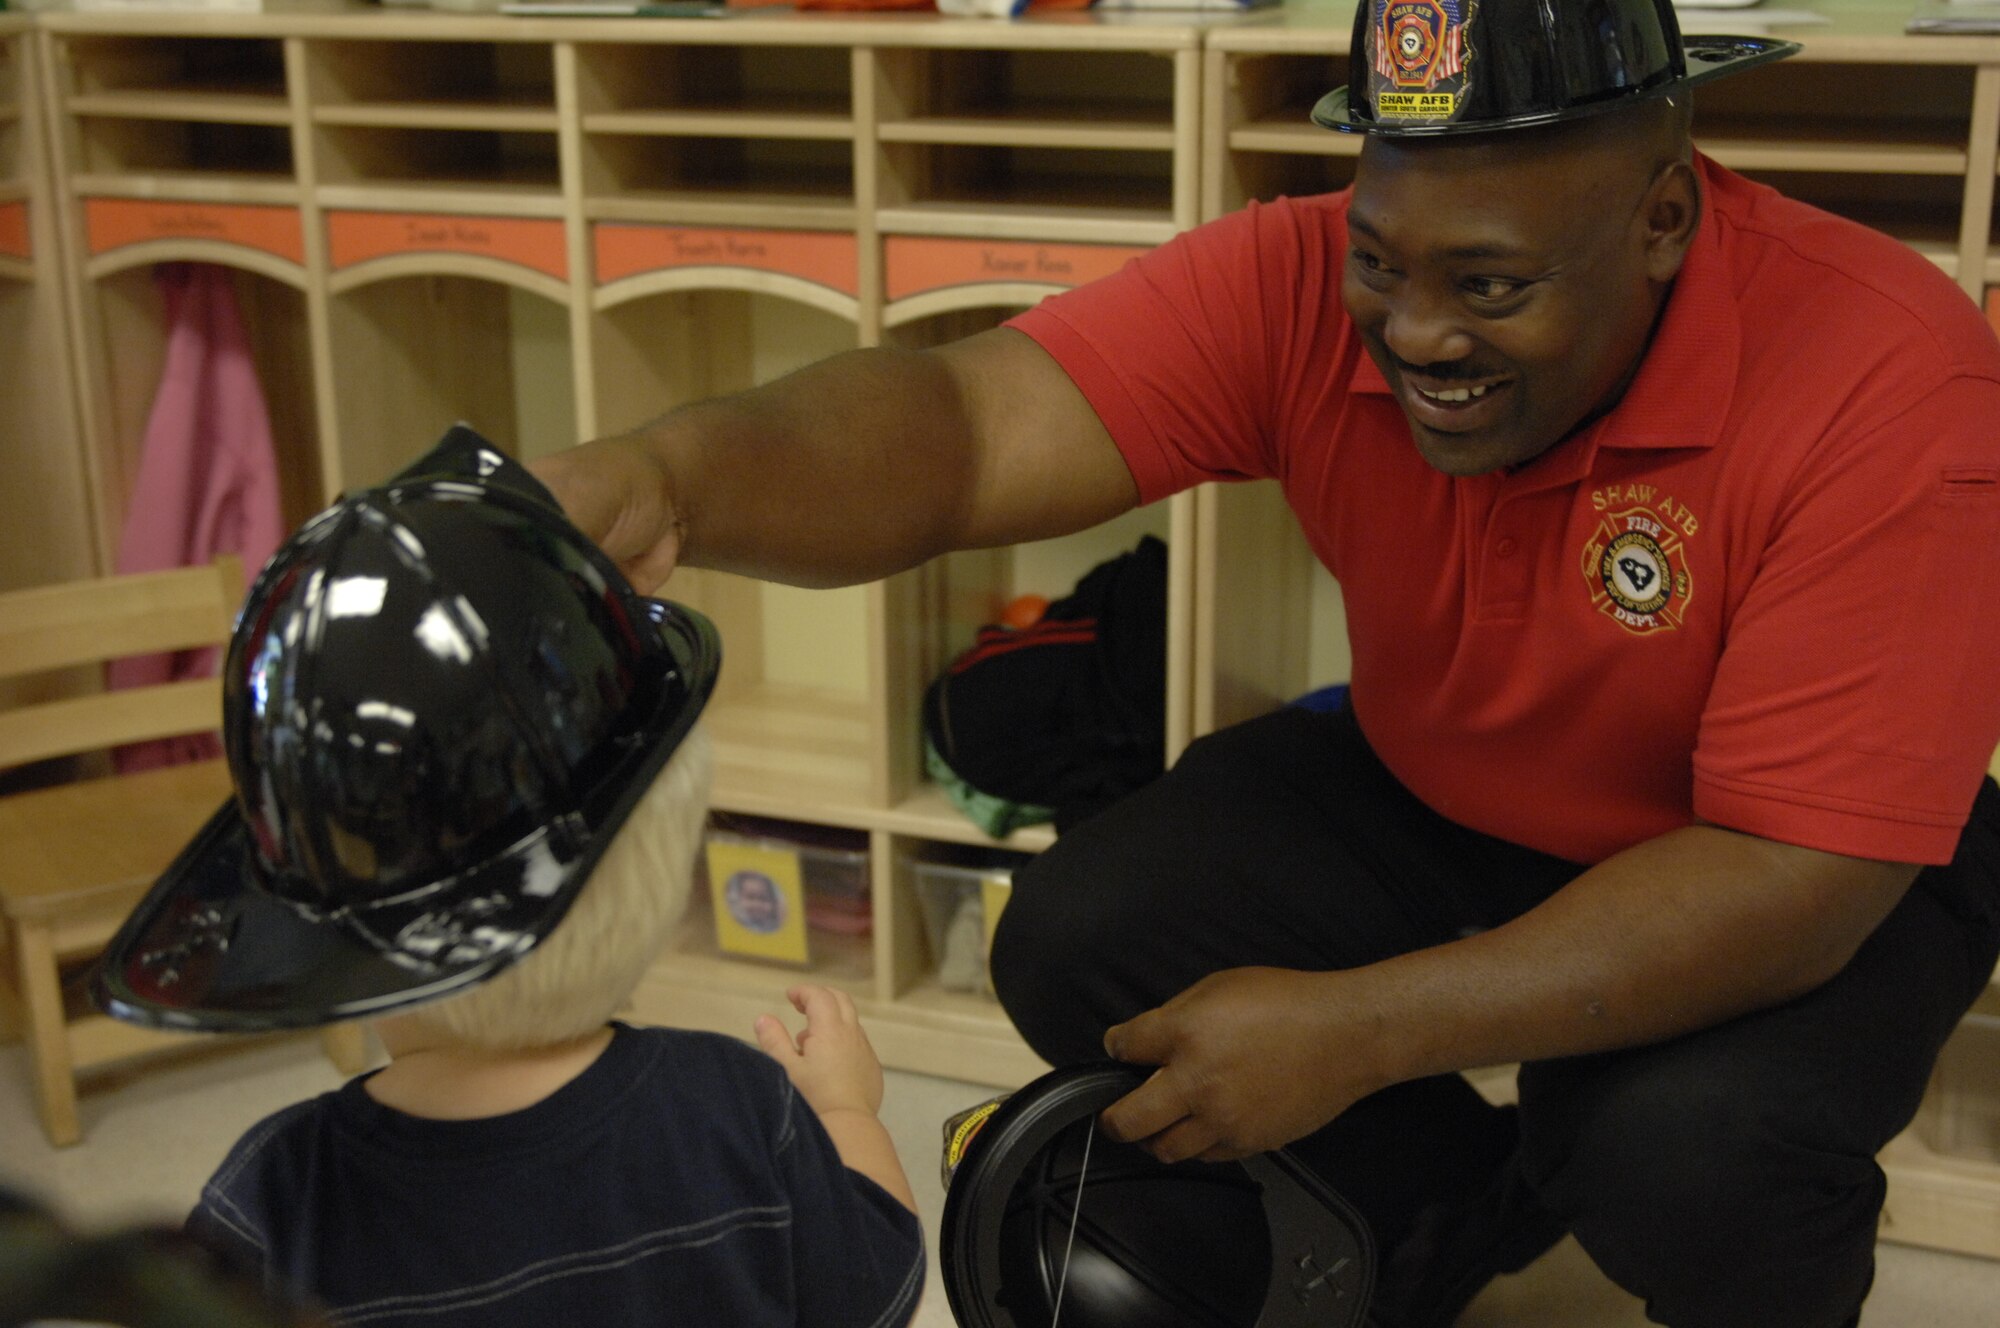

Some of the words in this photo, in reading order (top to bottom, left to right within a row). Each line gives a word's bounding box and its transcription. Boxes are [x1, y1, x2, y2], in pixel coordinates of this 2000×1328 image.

[1391, 5, 1414, 18] SHAW
[1416, 6, 1432, 18] AFB
[1380, 95, 1414, 105] SHAW
[1420, 95, 1450, 105] AFB
[1591, 484, 1658, 511] SHAW
[1658, 496, 1698, 537] AFB
[1626, 516, 1661, 538] FIRE
[1613, 607, 1659, 628] DEPT.
